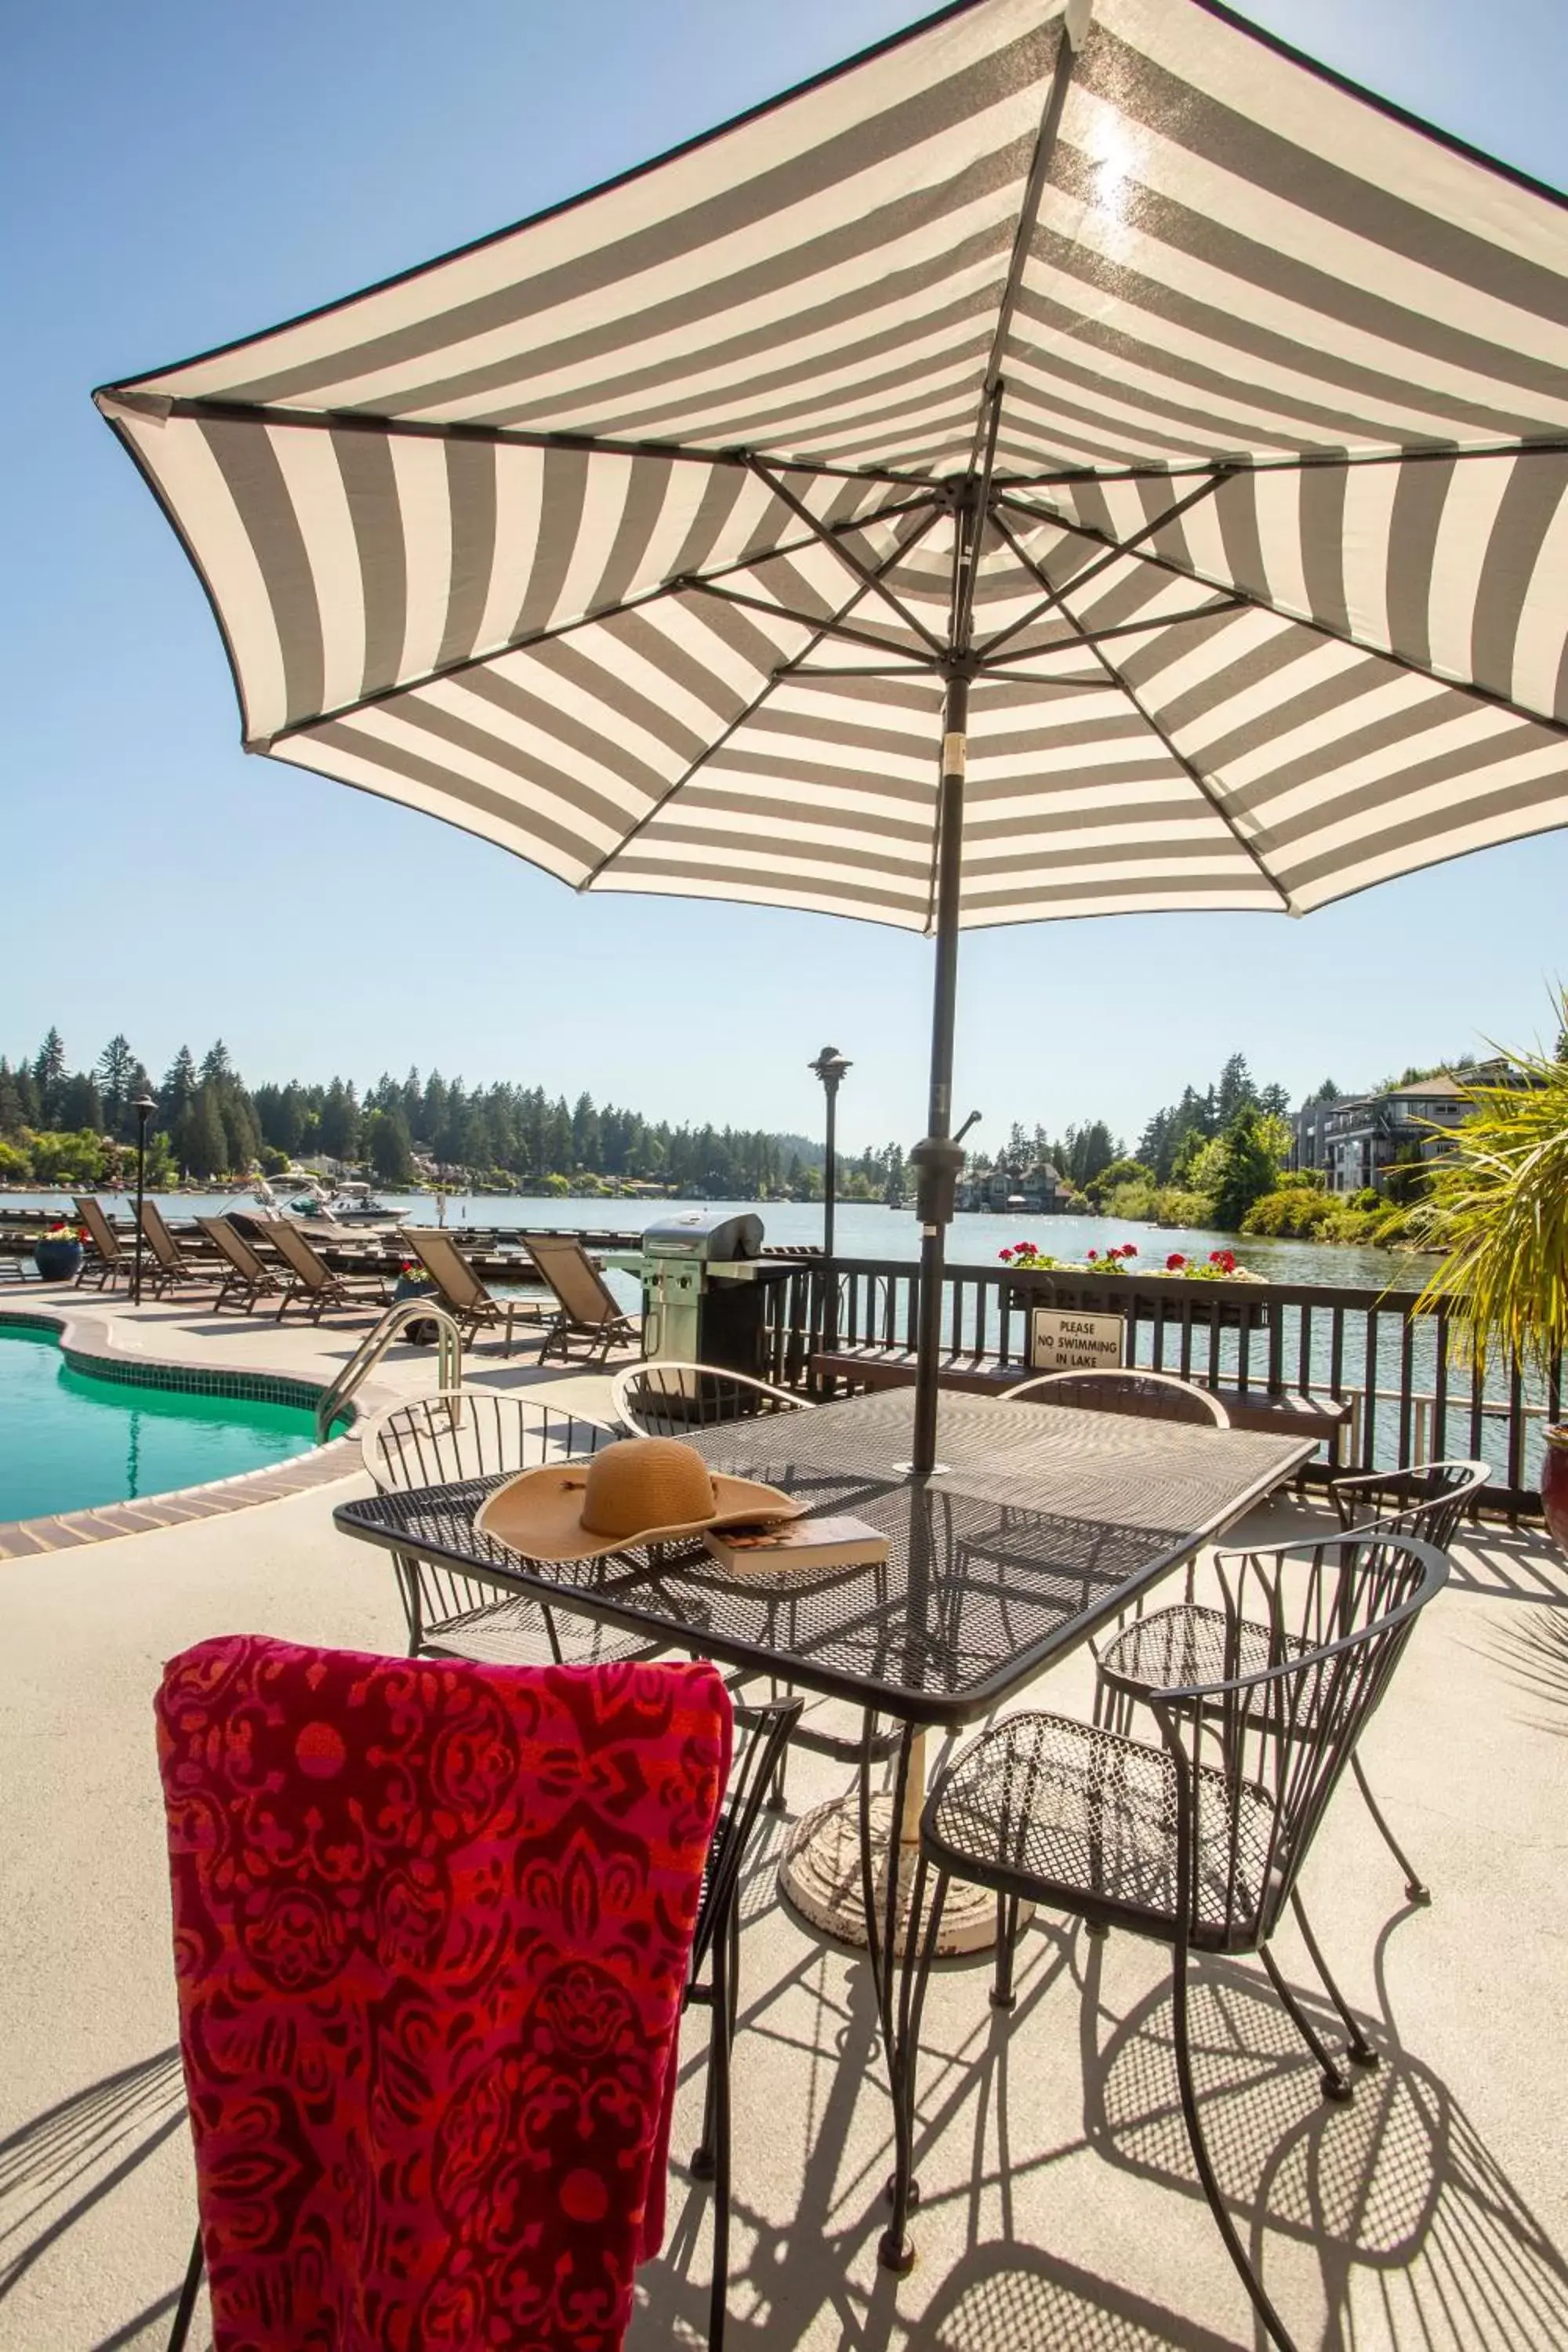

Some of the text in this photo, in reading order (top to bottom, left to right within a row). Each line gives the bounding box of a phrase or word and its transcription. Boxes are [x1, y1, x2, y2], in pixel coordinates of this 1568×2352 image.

[1060, 1320, 1095, 1334] PLEASE
[1037, 1334, 1117, 1353] NO SWIMMING
[1056, 1353, 1098, 1367] IN LAKE
